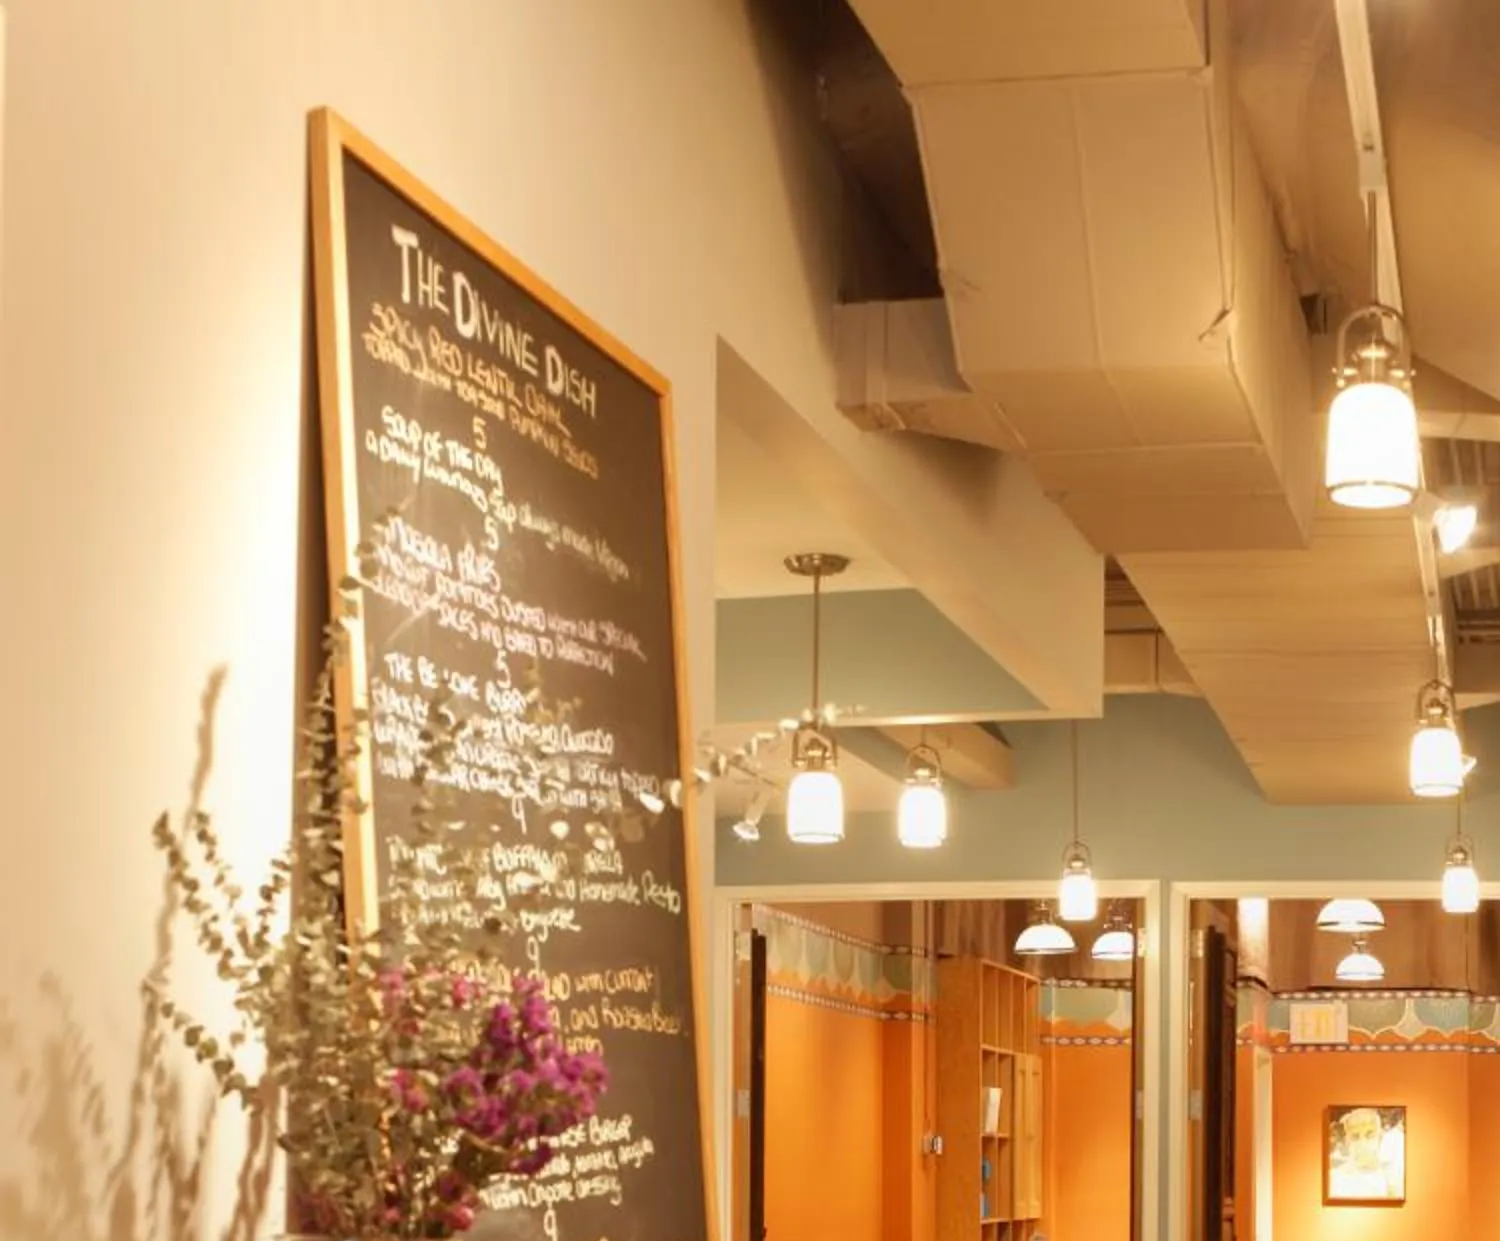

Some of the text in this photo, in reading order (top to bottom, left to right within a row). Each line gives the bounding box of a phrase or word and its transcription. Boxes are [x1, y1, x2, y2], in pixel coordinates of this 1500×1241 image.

[391, 224, 597, 418] THE DIVINE DISH
[367, 303, 428, 373] SPICY
[429, 326, 463, 376] RED
[468, 362, 520, 407] LENTIL
[382, 405, 503, 498] SOUP OF THE DAY
[473, 417, 487, 450] 5
[384, 652, 413, 684] THE
[494, 649, 511, 690] 5
